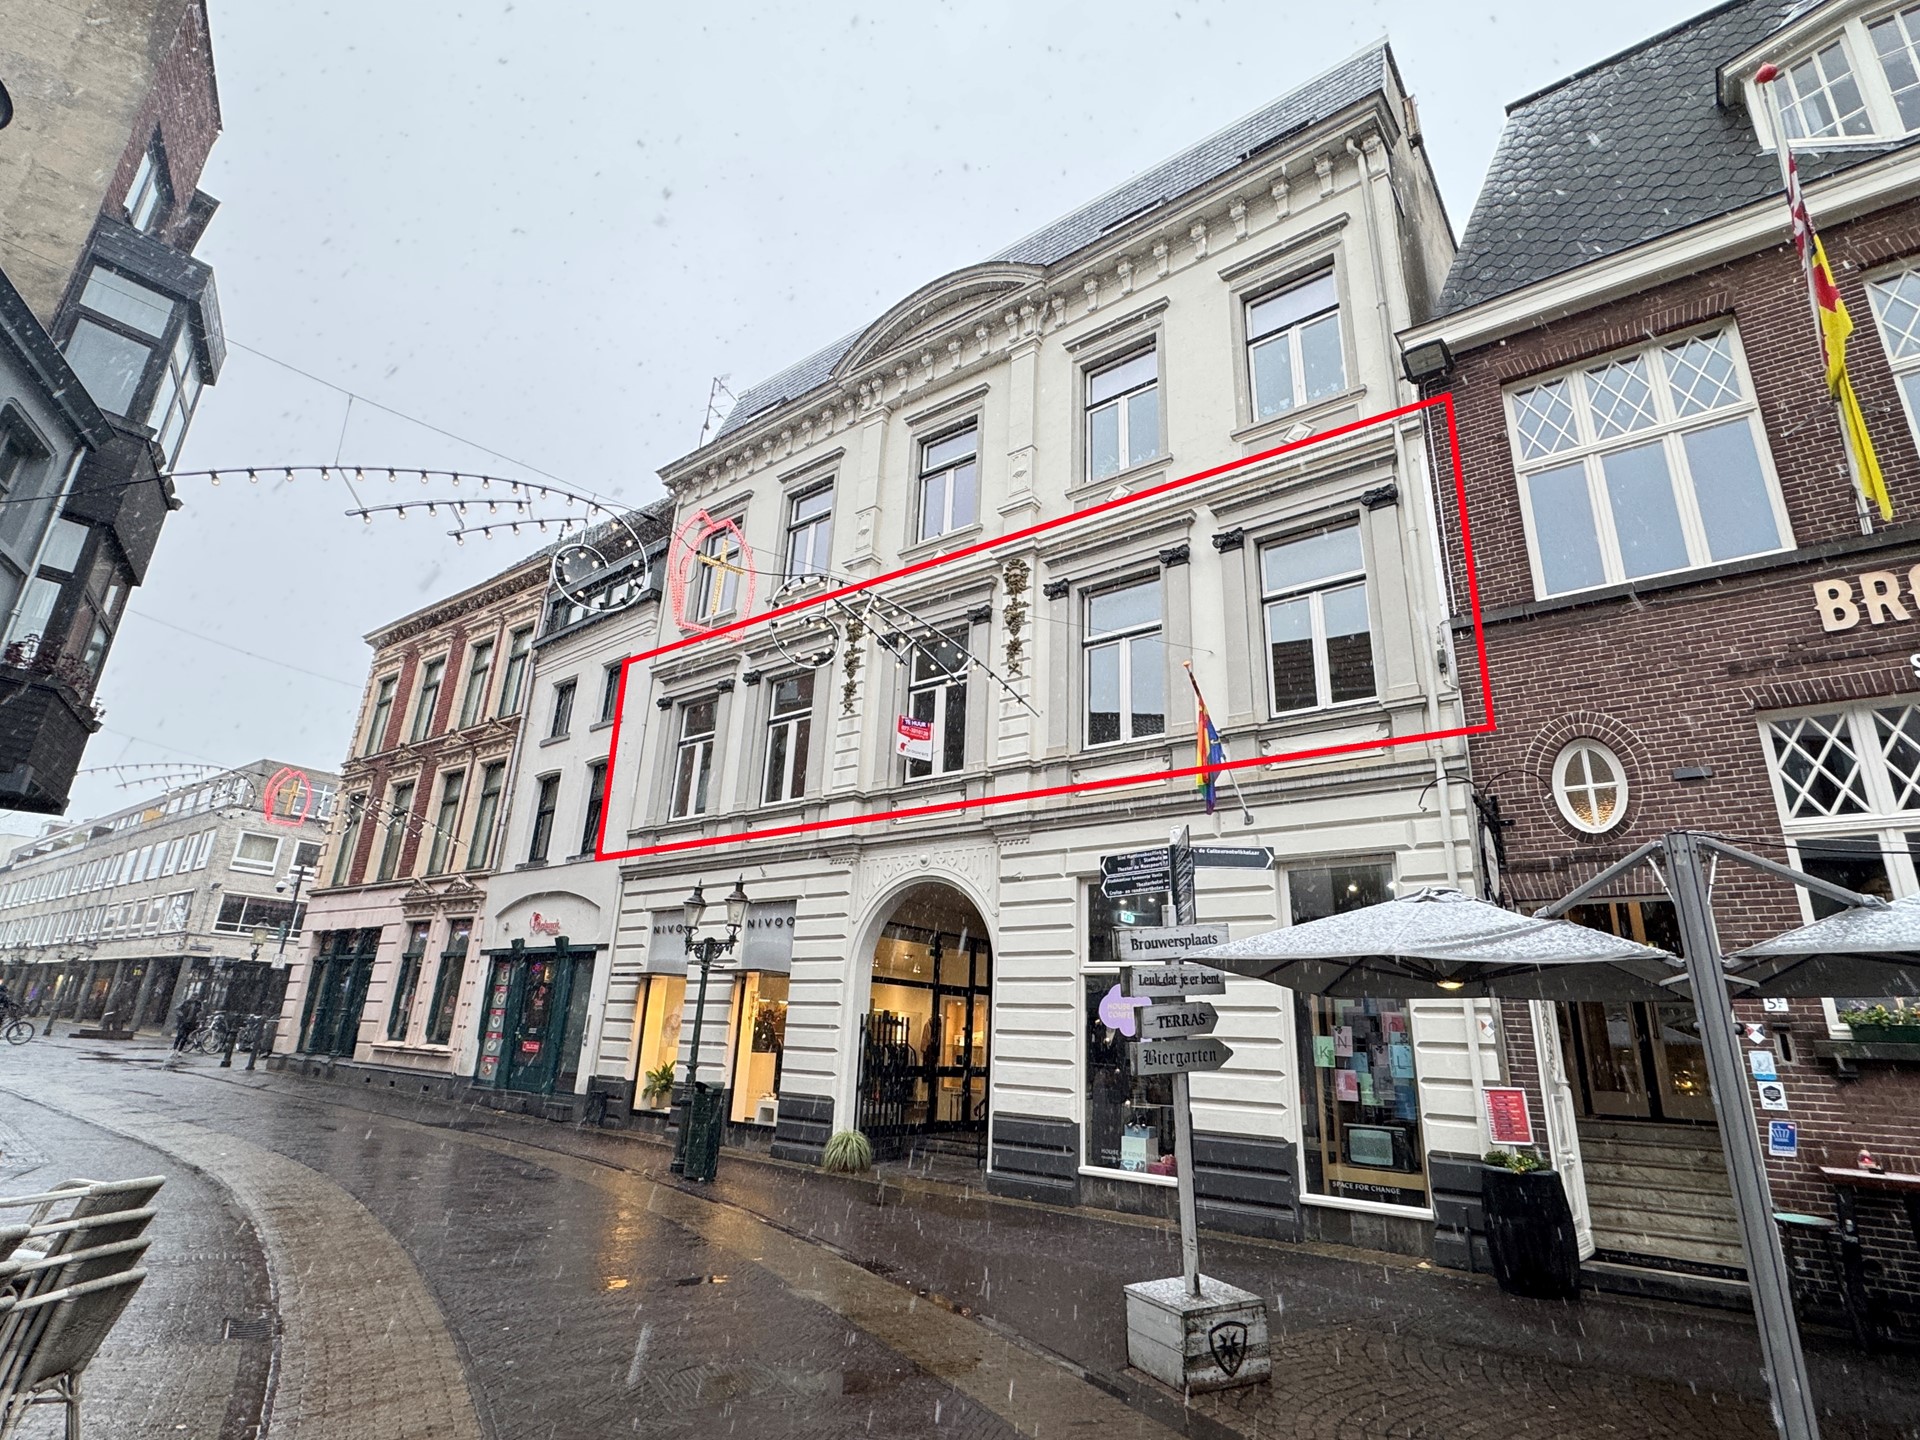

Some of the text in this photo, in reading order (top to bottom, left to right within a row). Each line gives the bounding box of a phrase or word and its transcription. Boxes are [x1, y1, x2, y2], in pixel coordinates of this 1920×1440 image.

[1813, 563, 1920, 632] BR
[912, 720, 927, 728] HUUR
[1130, 933, 1218, 951] Brouwersplaats
[1138, 973, 1220, 989] Leuk dat je er bent
[1157, 1012, 1206, 1029] TERRAS
[1143, 1049, 1217, 1067] Biergarten
[1332, 1181, 1401, 1195] SPACE FOR CHANGE
